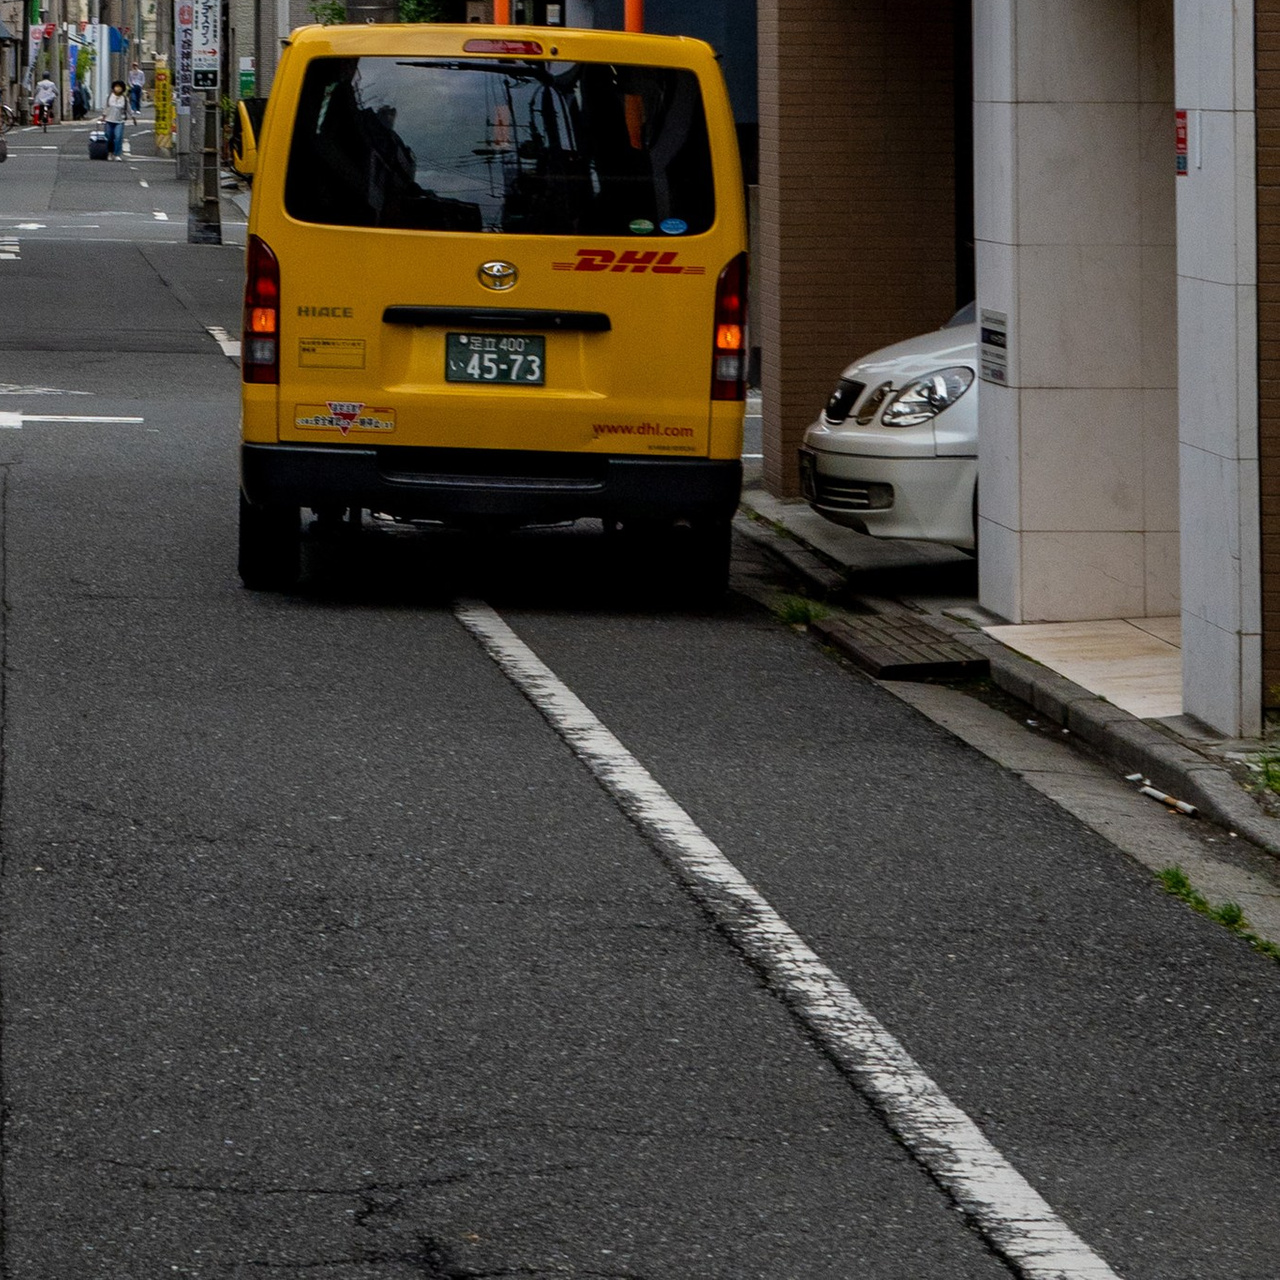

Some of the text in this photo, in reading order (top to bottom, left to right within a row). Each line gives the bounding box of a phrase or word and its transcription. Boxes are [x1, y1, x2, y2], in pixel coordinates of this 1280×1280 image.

[574, 249, 685, 274] DHL
[297, 306, 354, 318] HIACE
[468, 336, 526, 352] 足立 400
[466, 353, 541, 381] 45-73
[592, 422, 695, 438] www.dhl.com
